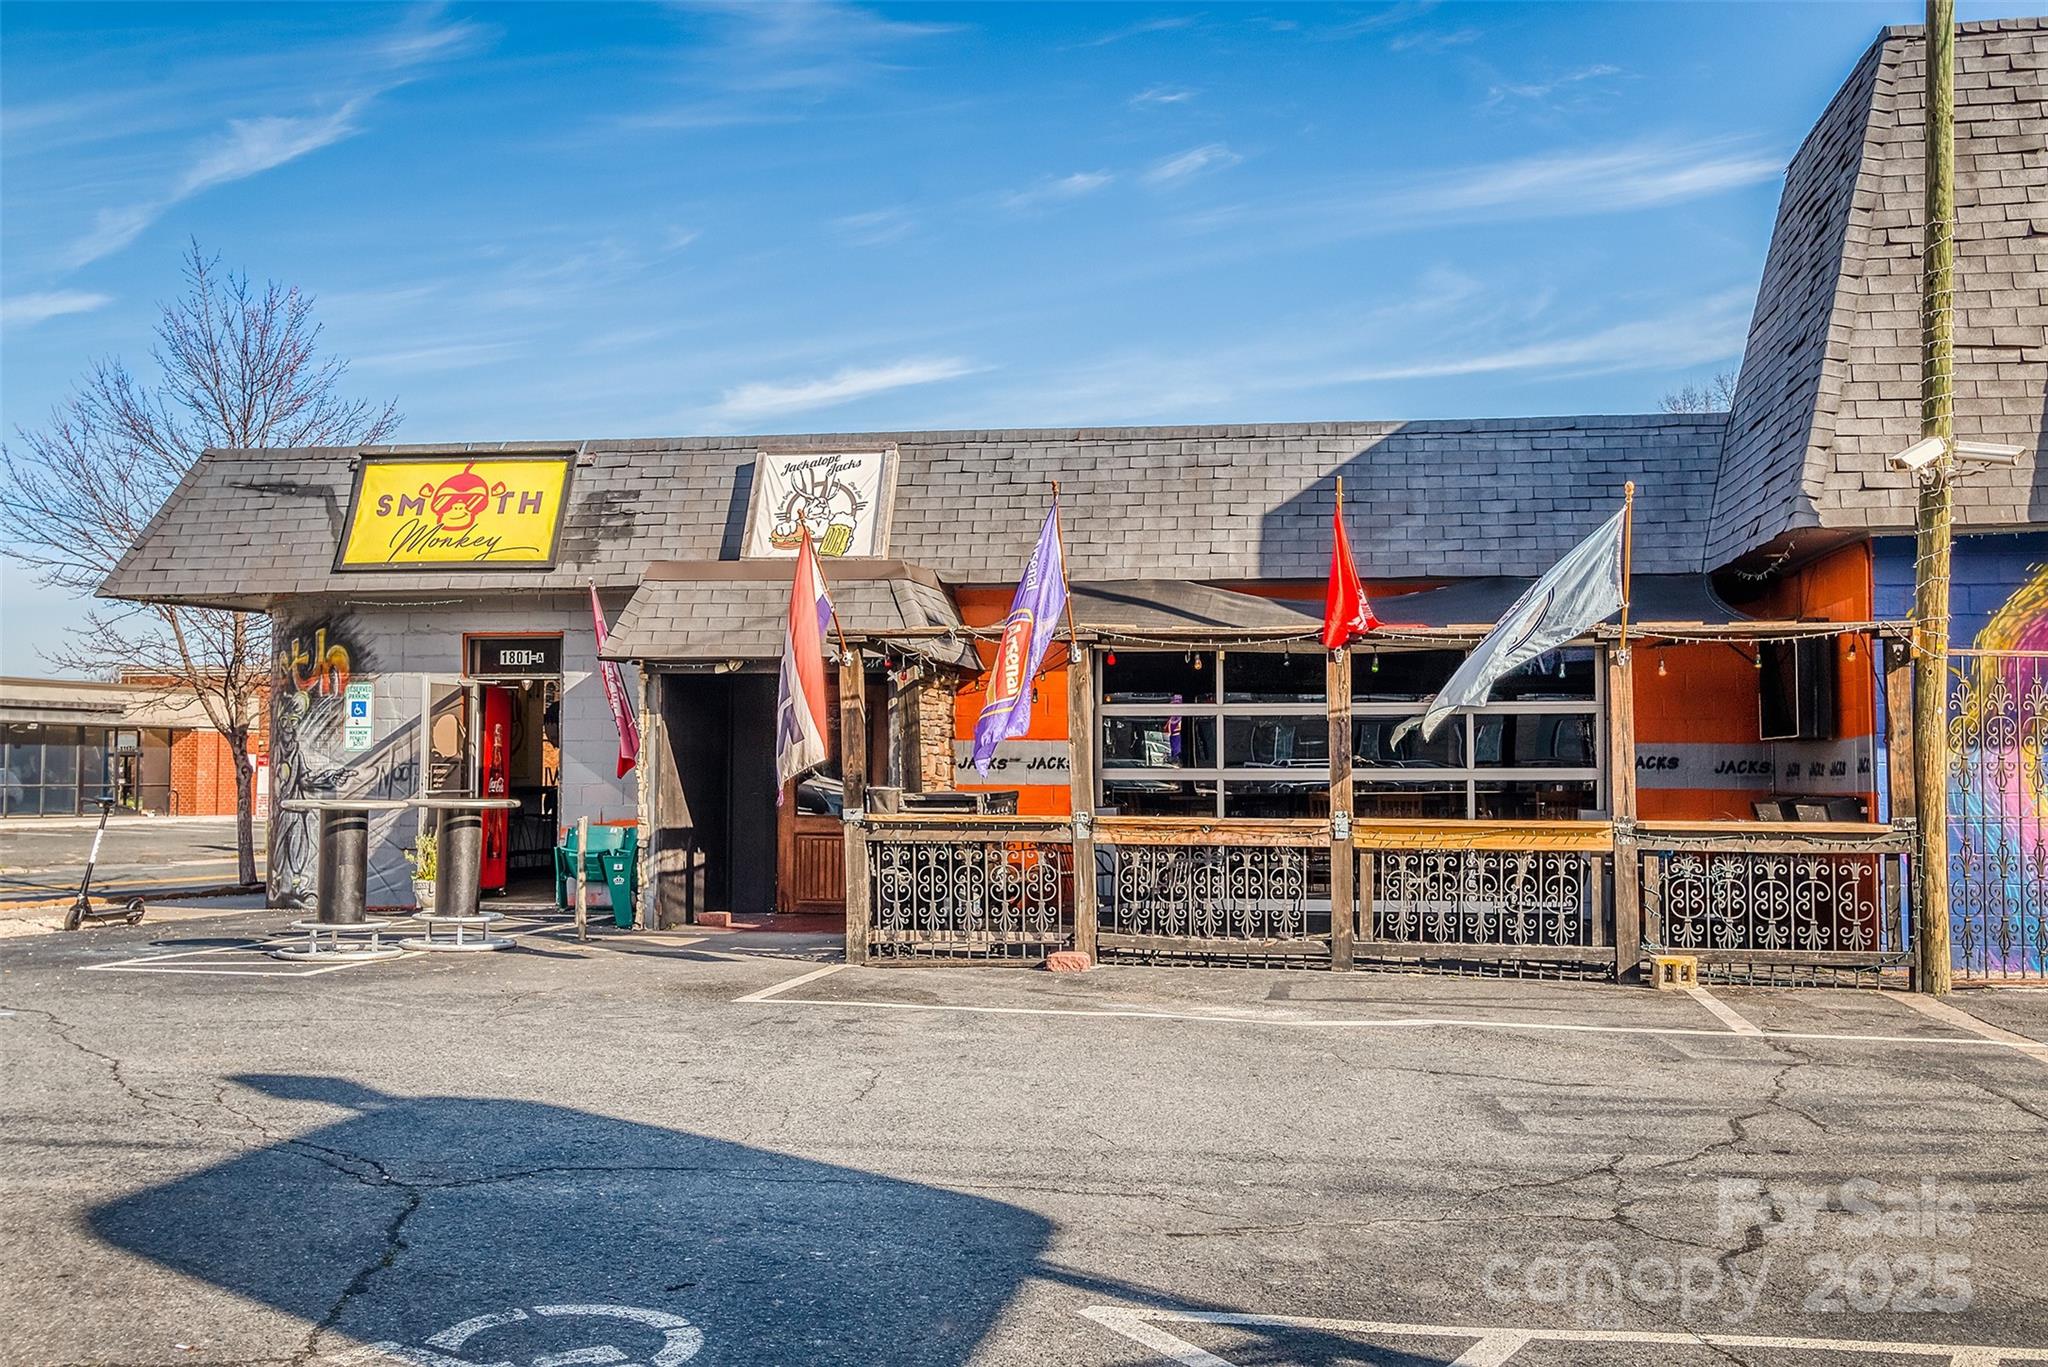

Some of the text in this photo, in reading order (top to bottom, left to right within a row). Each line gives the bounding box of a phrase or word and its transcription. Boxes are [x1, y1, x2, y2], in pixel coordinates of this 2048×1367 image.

[780, 454, 841, 477] Jackalope
[826, 459, 862, 477] Jacks
[388, 517, 540, 562] Monkey
[501, 650, 544, 664] 1801-A
[1005, 623, 1022, 696] Arsenal
[958, 757, 1008, 770] JAKS
[1635, 756, 1772, 774] ACKS JACKS
